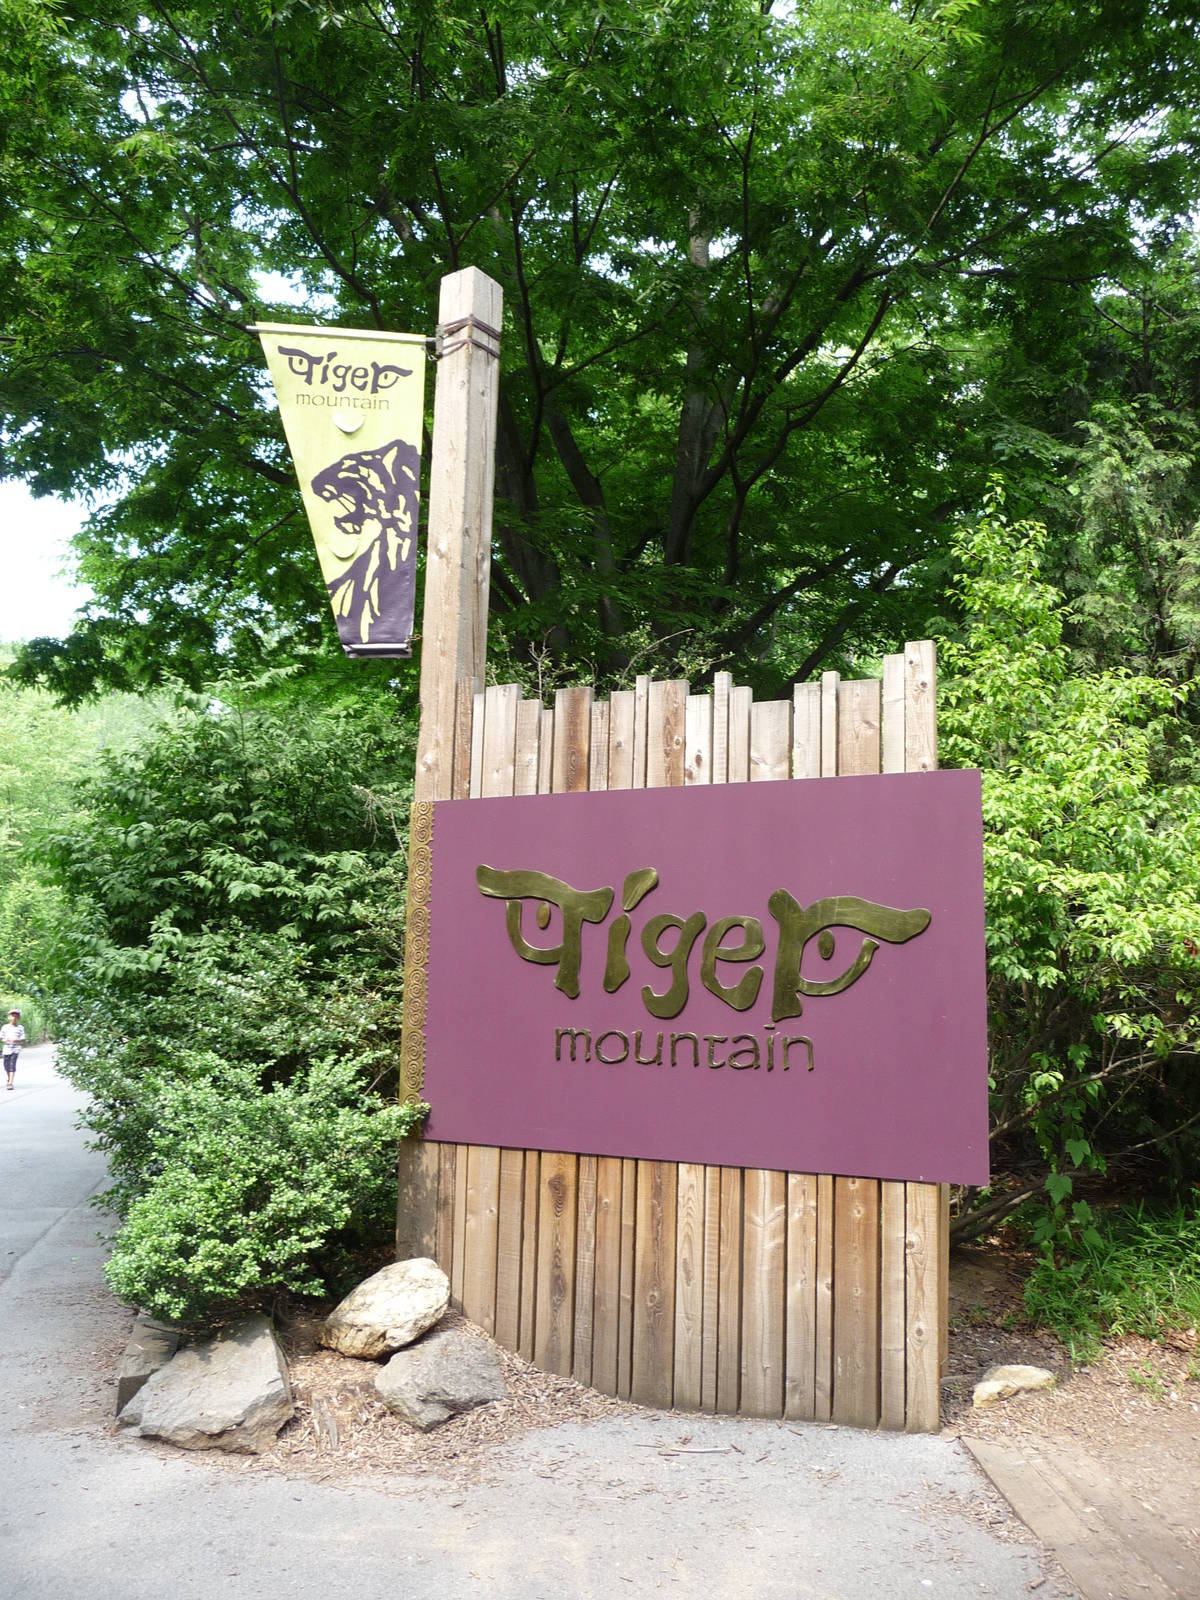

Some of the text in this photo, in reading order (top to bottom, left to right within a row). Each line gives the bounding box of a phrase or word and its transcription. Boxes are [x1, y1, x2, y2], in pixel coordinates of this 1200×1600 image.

[277, 345, 413, 394] Tiger
[296, 393, 390, 410] mountain
[476, 864, 932, 1022] Tiger
[555, 1024, 814, 1072] mountain
